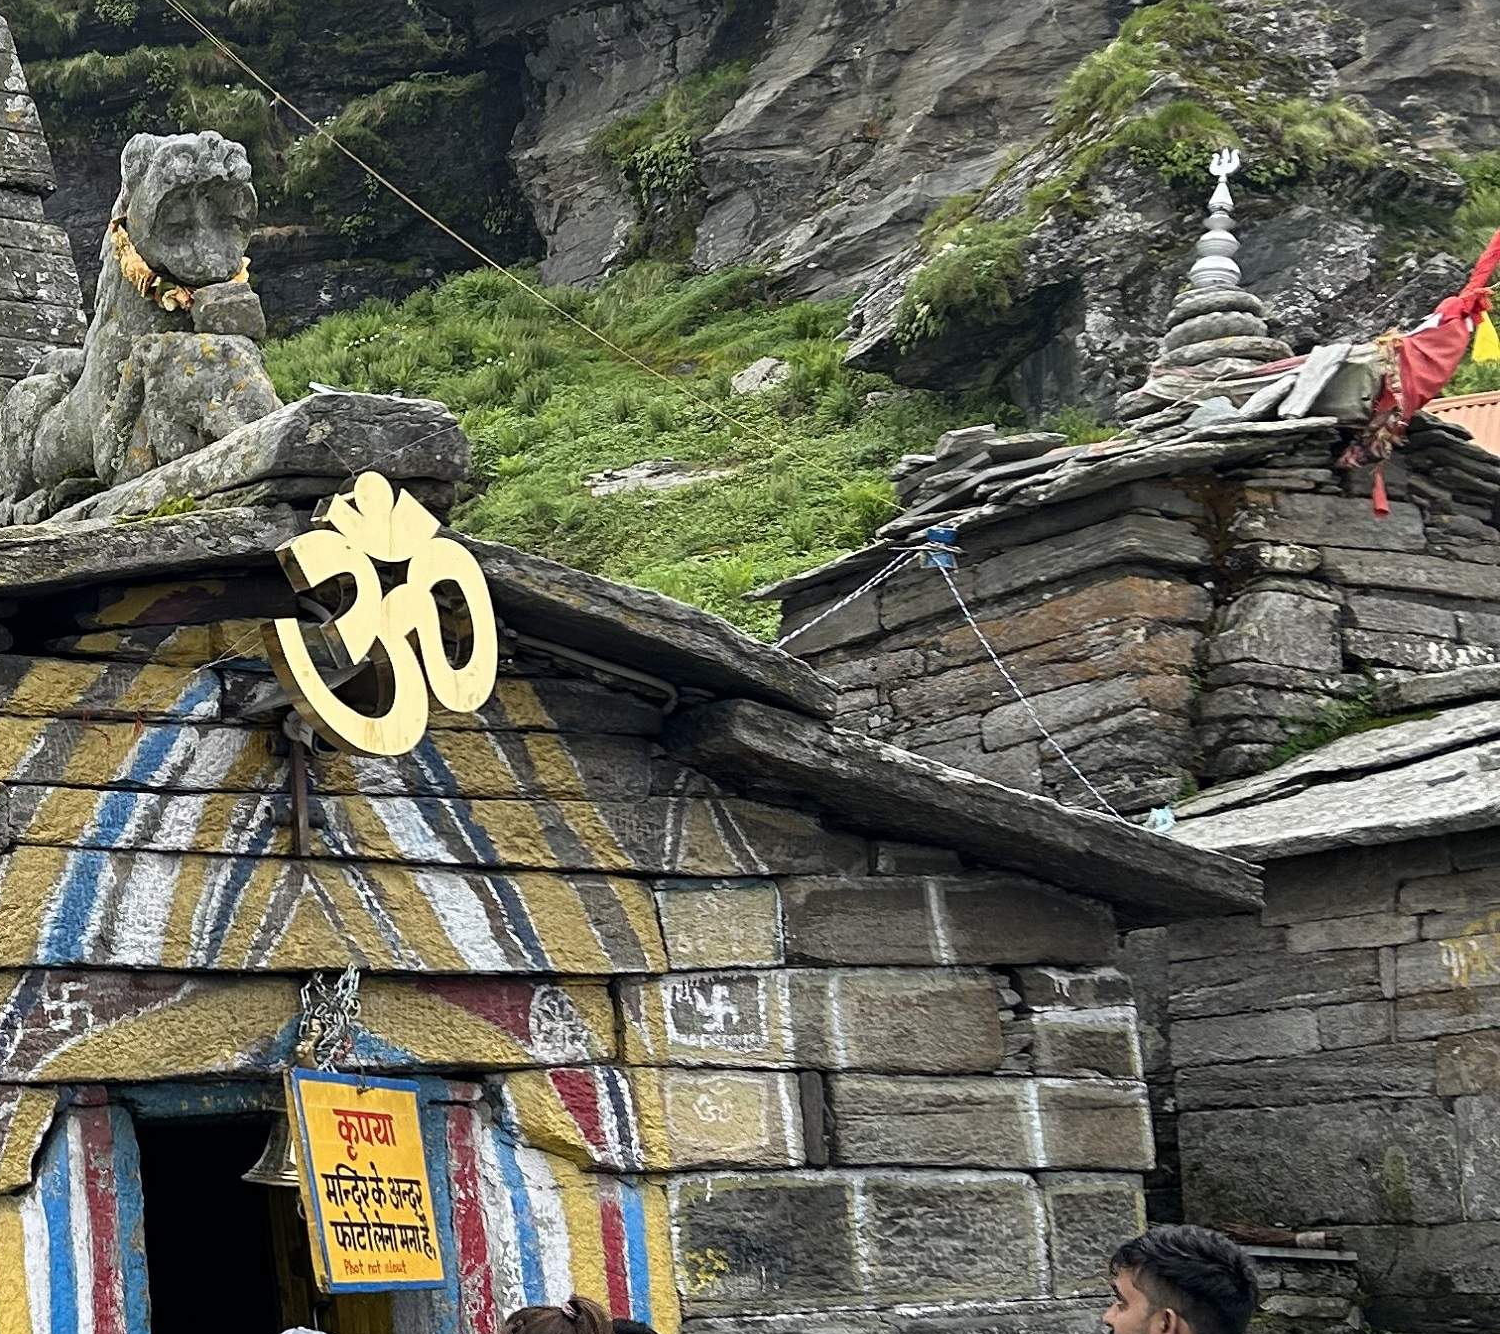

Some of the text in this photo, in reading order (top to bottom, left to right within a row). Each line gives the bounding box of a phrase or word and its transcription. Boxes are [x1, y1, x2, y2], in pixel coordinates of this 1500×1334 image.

[332, 1108, 397, 1161] कृपया
[321, 1161, 423, 1216] मन्दिर के अन्दर
[329, 1210, 374, 1252] फोटो
[371, 1210, 398, 1252] लेना
[396, 1224, 422, 1253] मना
